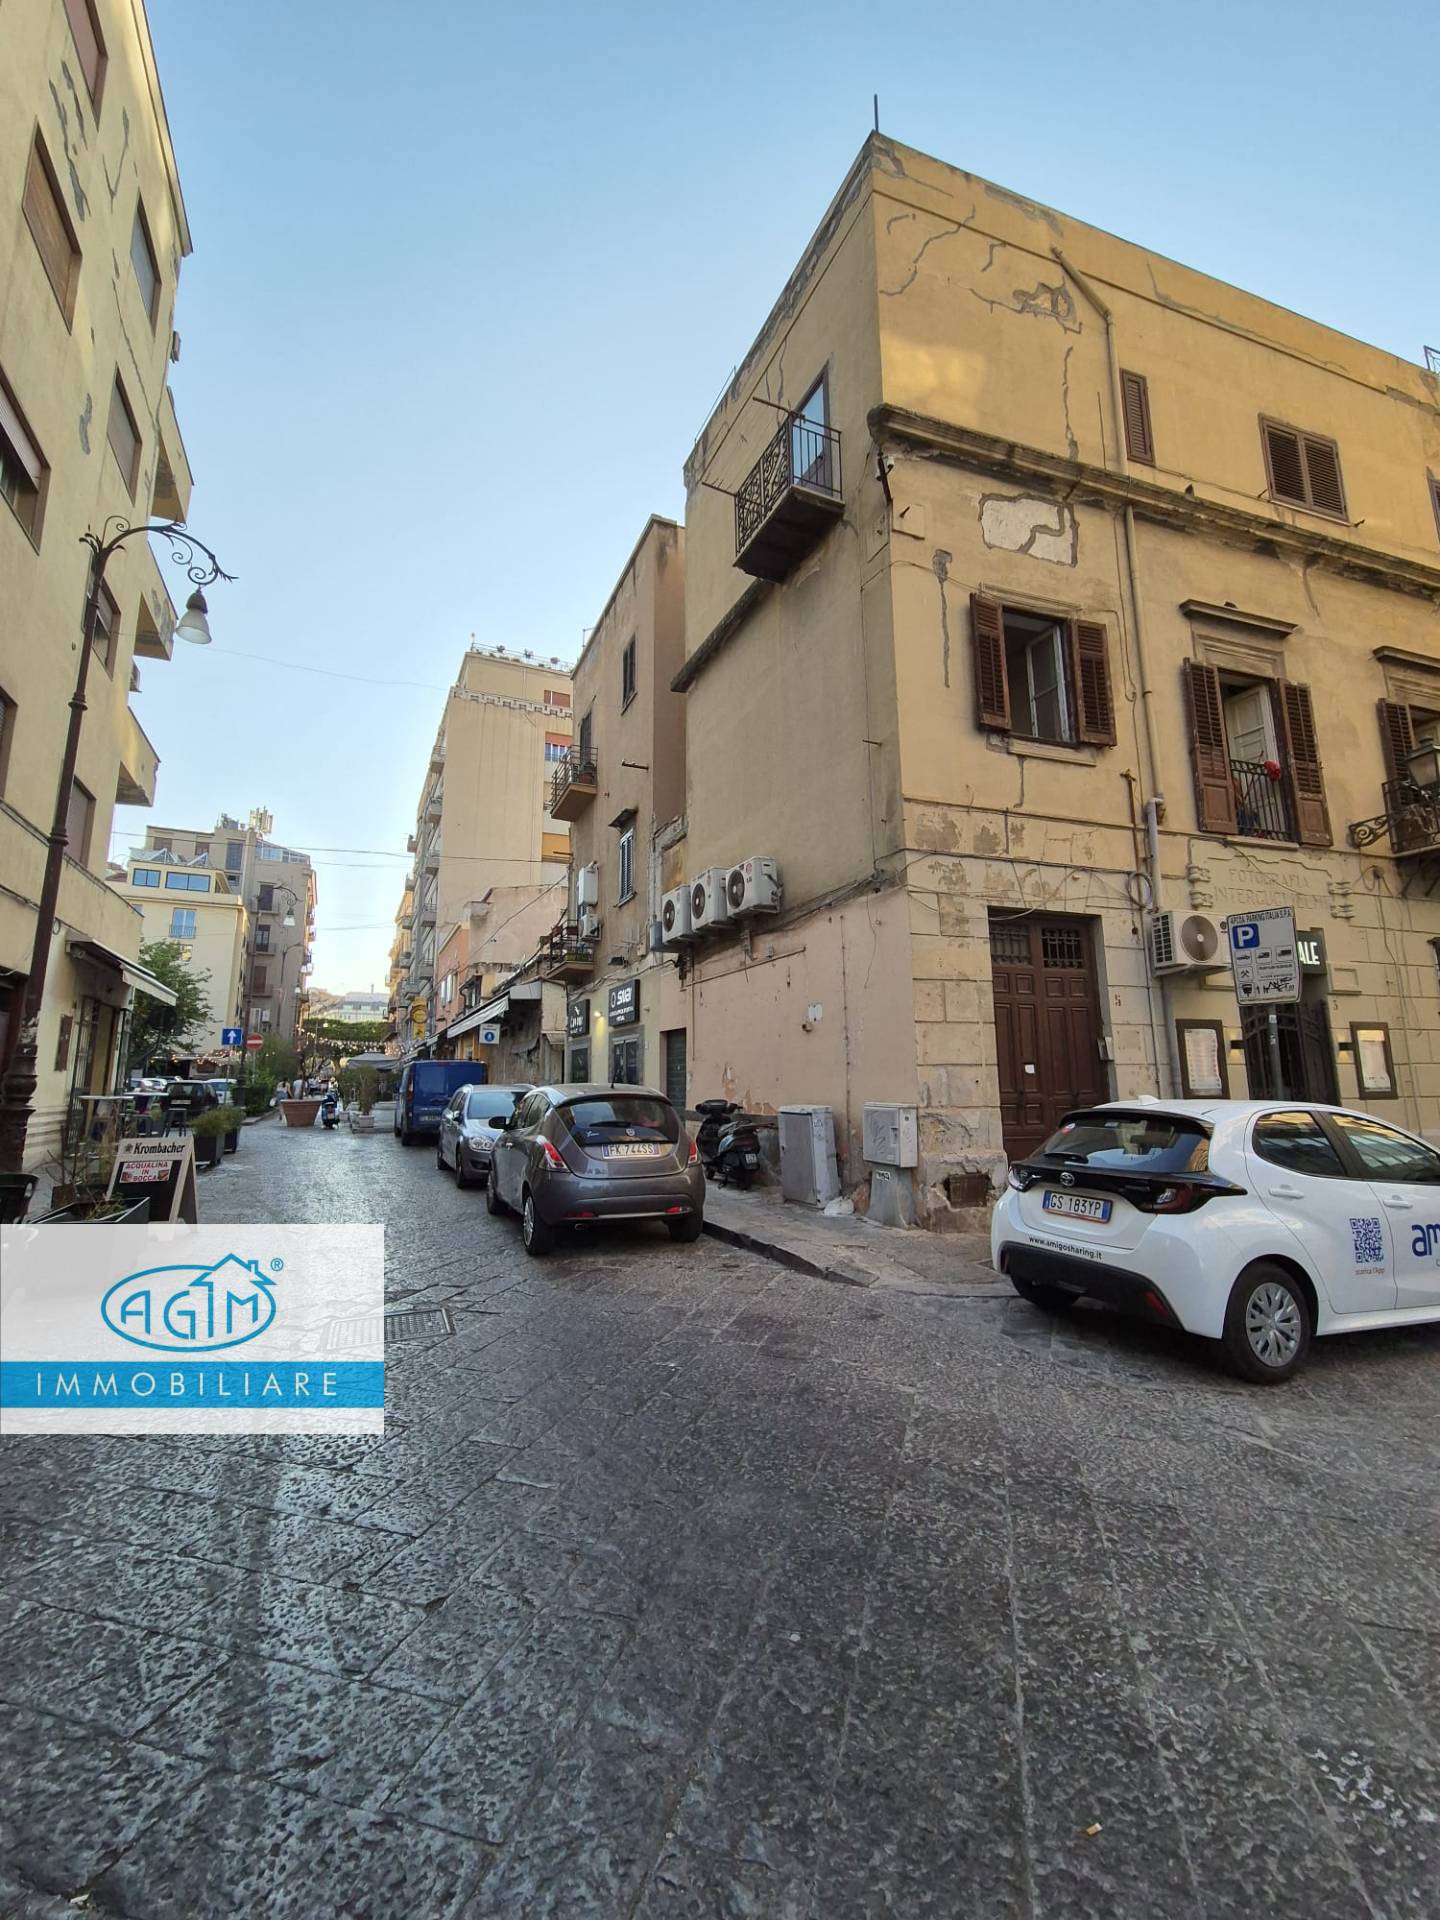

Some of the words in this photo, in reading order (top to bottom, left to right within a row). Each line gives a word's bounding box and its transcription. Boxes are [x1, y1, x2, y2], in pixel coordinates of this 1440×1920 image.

[1237, 926, 1254, 947] P
[133, 1142, 186, 1155] Krombacher
[1050, 1194, 1064, 1209] GS
[1068, 1197, 1102, 1216] 183YP
[1028, 1235, 1102, 1260] www.amigosharing.it
